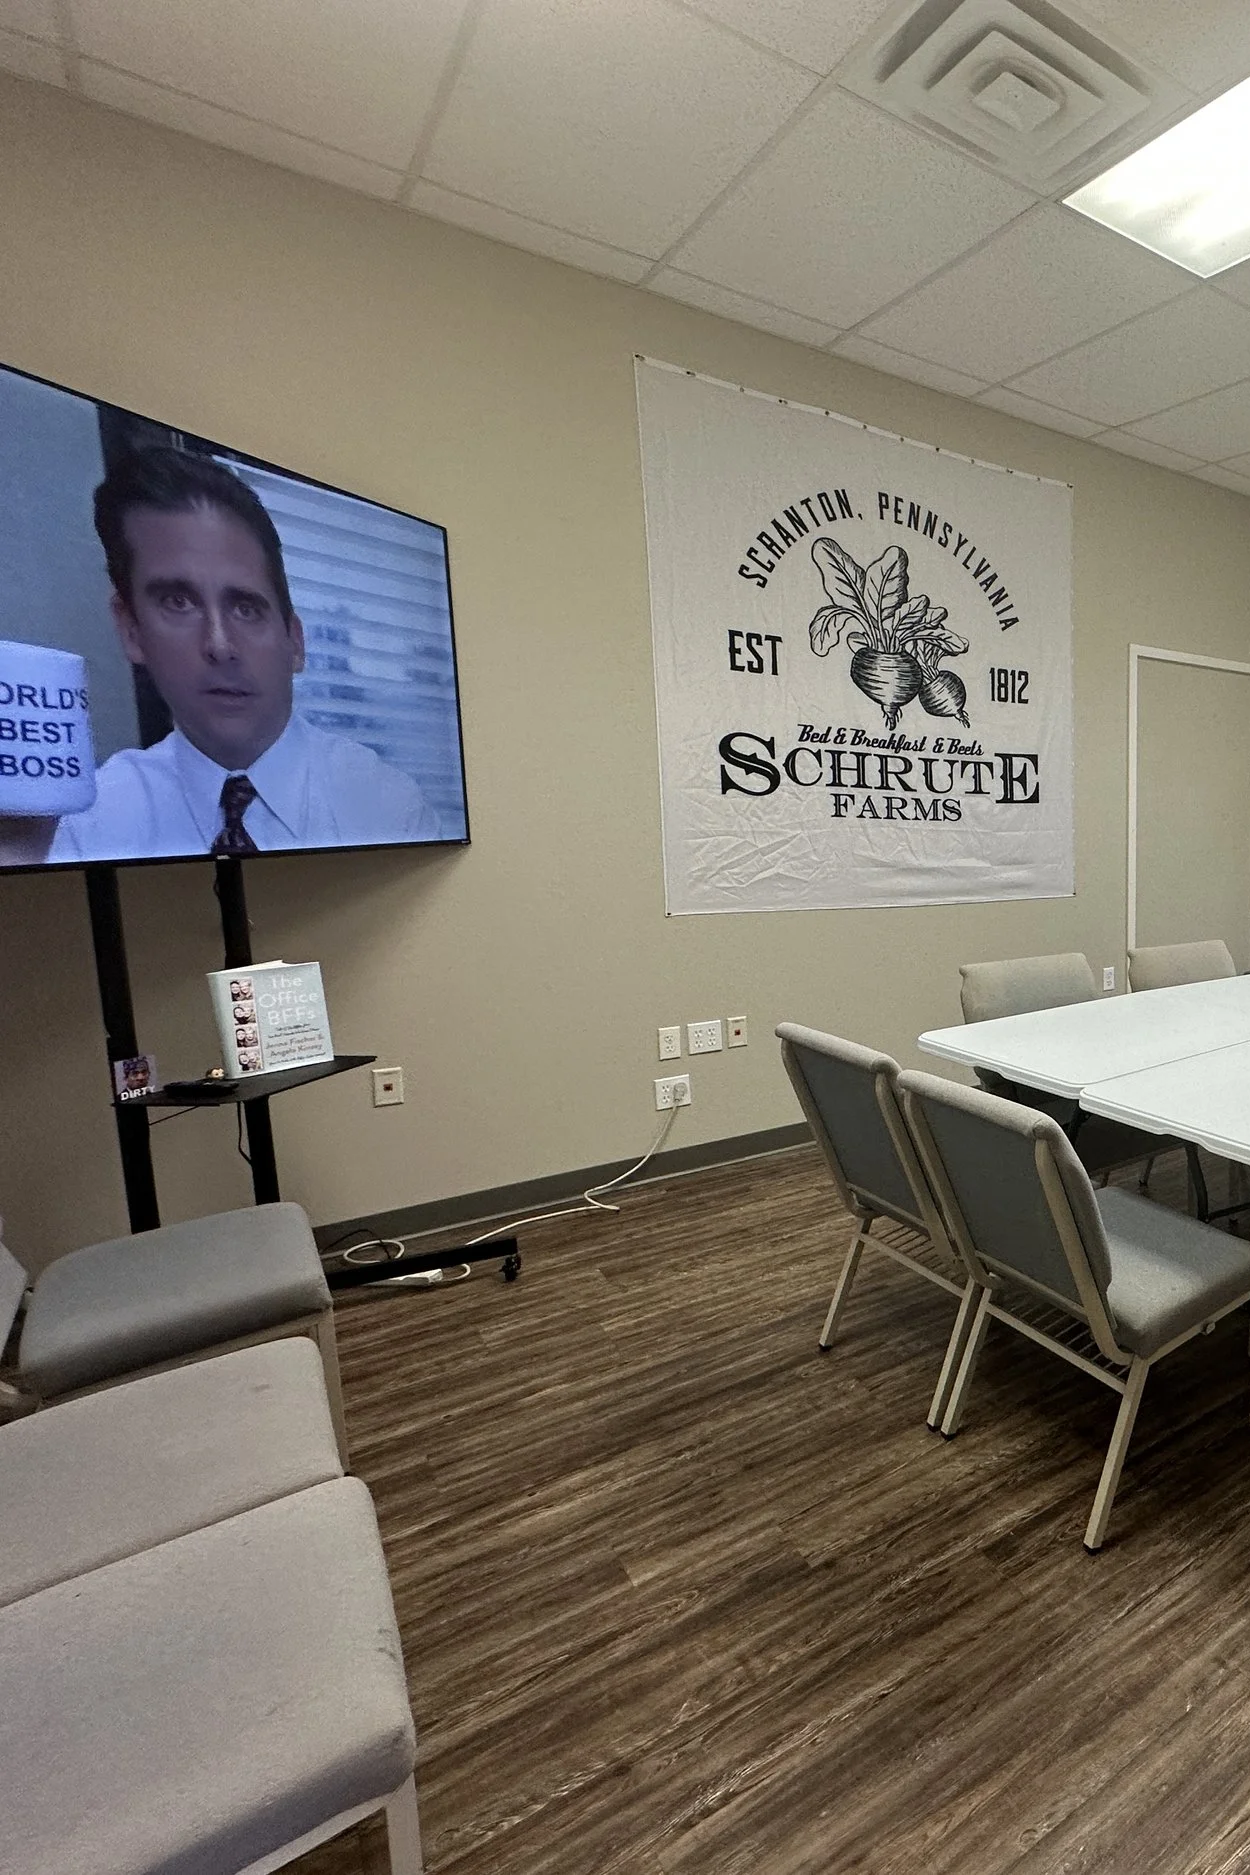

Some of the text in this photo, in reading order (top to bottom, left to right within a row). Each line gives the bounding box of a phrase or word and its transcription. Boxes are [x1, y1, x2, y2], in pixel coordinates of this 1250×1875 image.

[738, 489, 1020, 632] SCRANTON, PENNSYLVANIA
[728, 629, 783, 676] EST
[989, 667, 1029, 704] 1812
[0, 718, 76, 743] BEST
[797, 724, 984, 756] Bed & Breakfast & Beets
[0, 754, 81, 778] BOSS
[718, 731, 1040, 804] SCHRUTE
[831, 793, 962, 822] FARMS
[270, 975, 304, 989] The
[259, 990, 320, 1007] Office
[267, 1006, 316, 1025] BFFs
[121, 1085, 155, 1101] DIRTY
